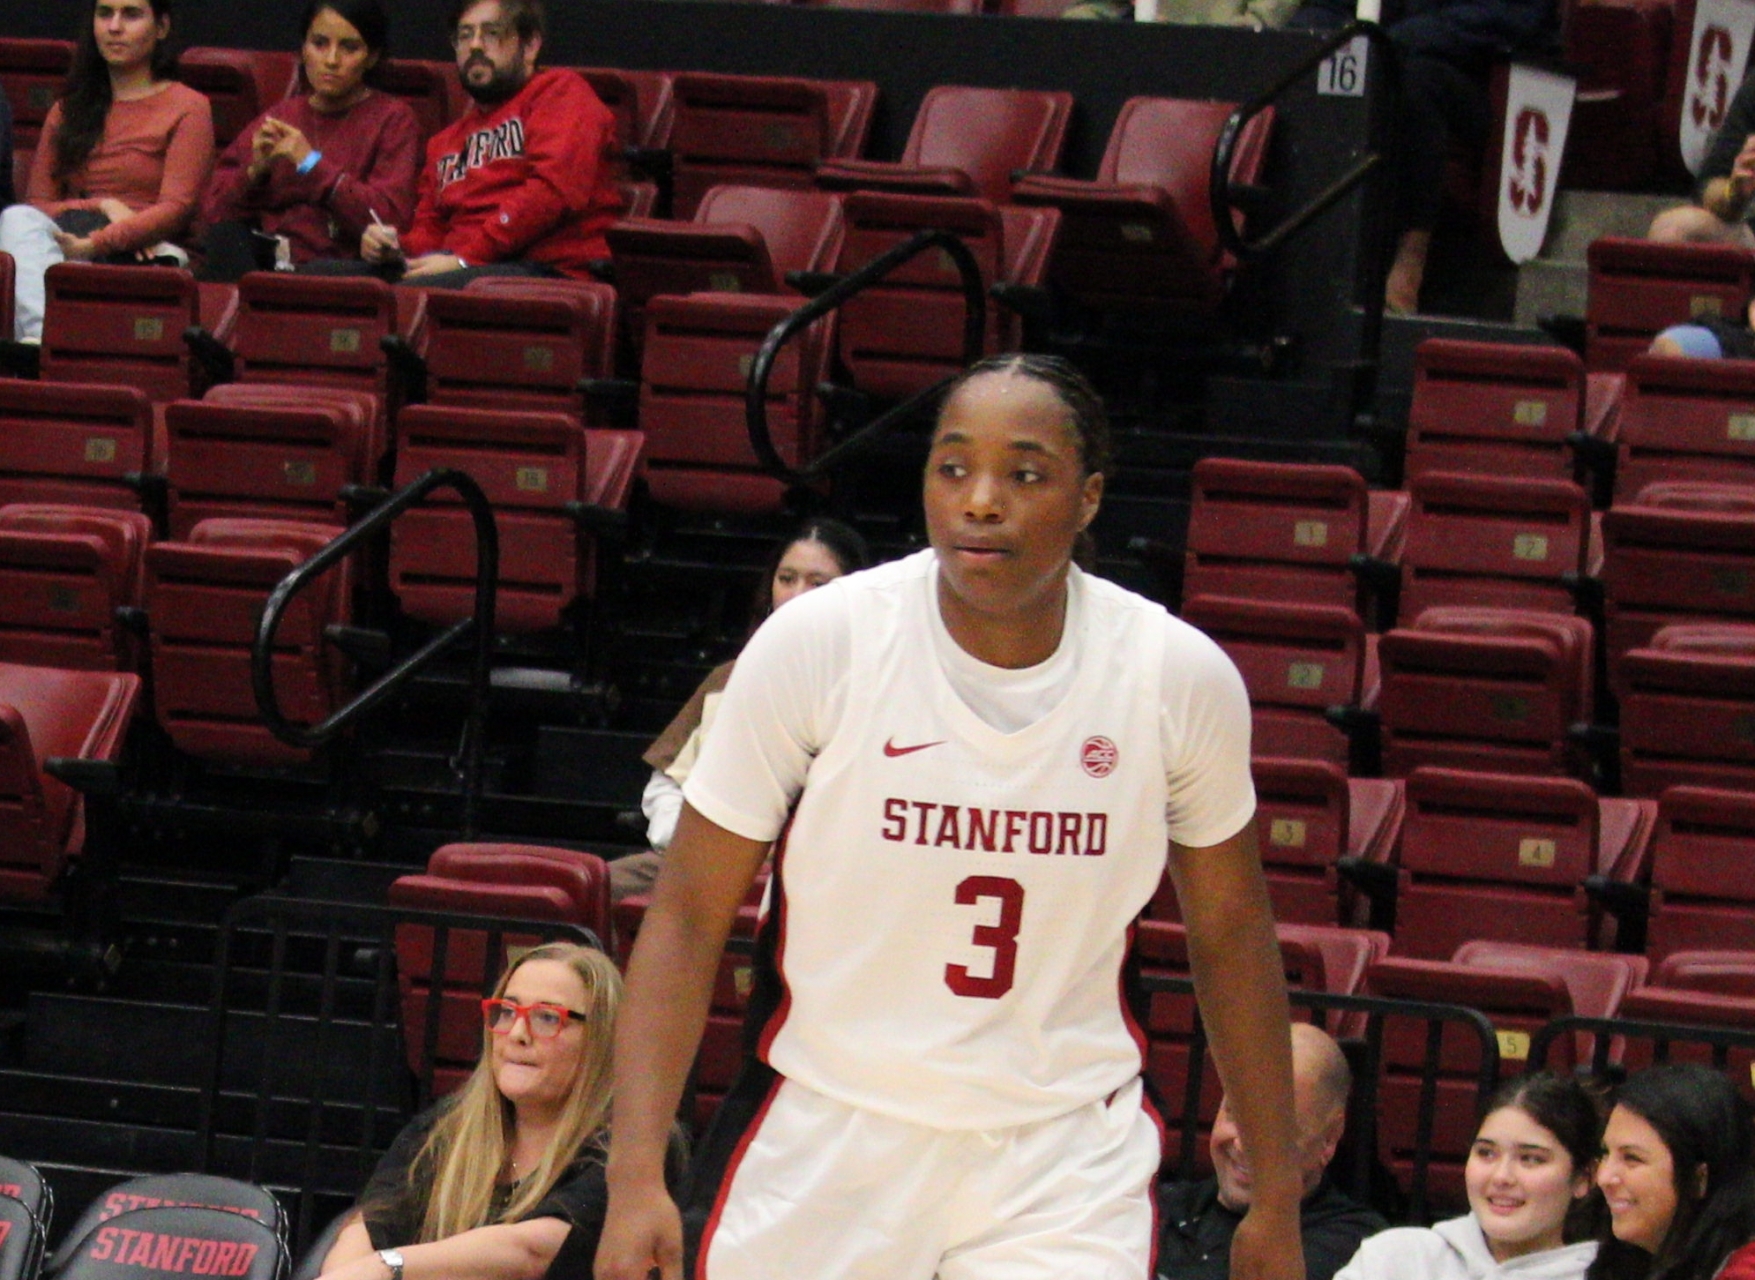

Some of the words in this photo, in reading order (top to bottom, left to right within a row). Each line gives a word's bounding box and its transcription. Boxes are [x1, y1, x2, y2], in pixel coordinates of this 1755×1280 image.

[1329, 56, 1357, 91] 16
[882, 798, 1107, 856] STANFORD
[943, 875, 1026, 999] 3
[1507, 1036, 1517, 1054] 5
[90, 1227, 259, 1277] STANFORD
